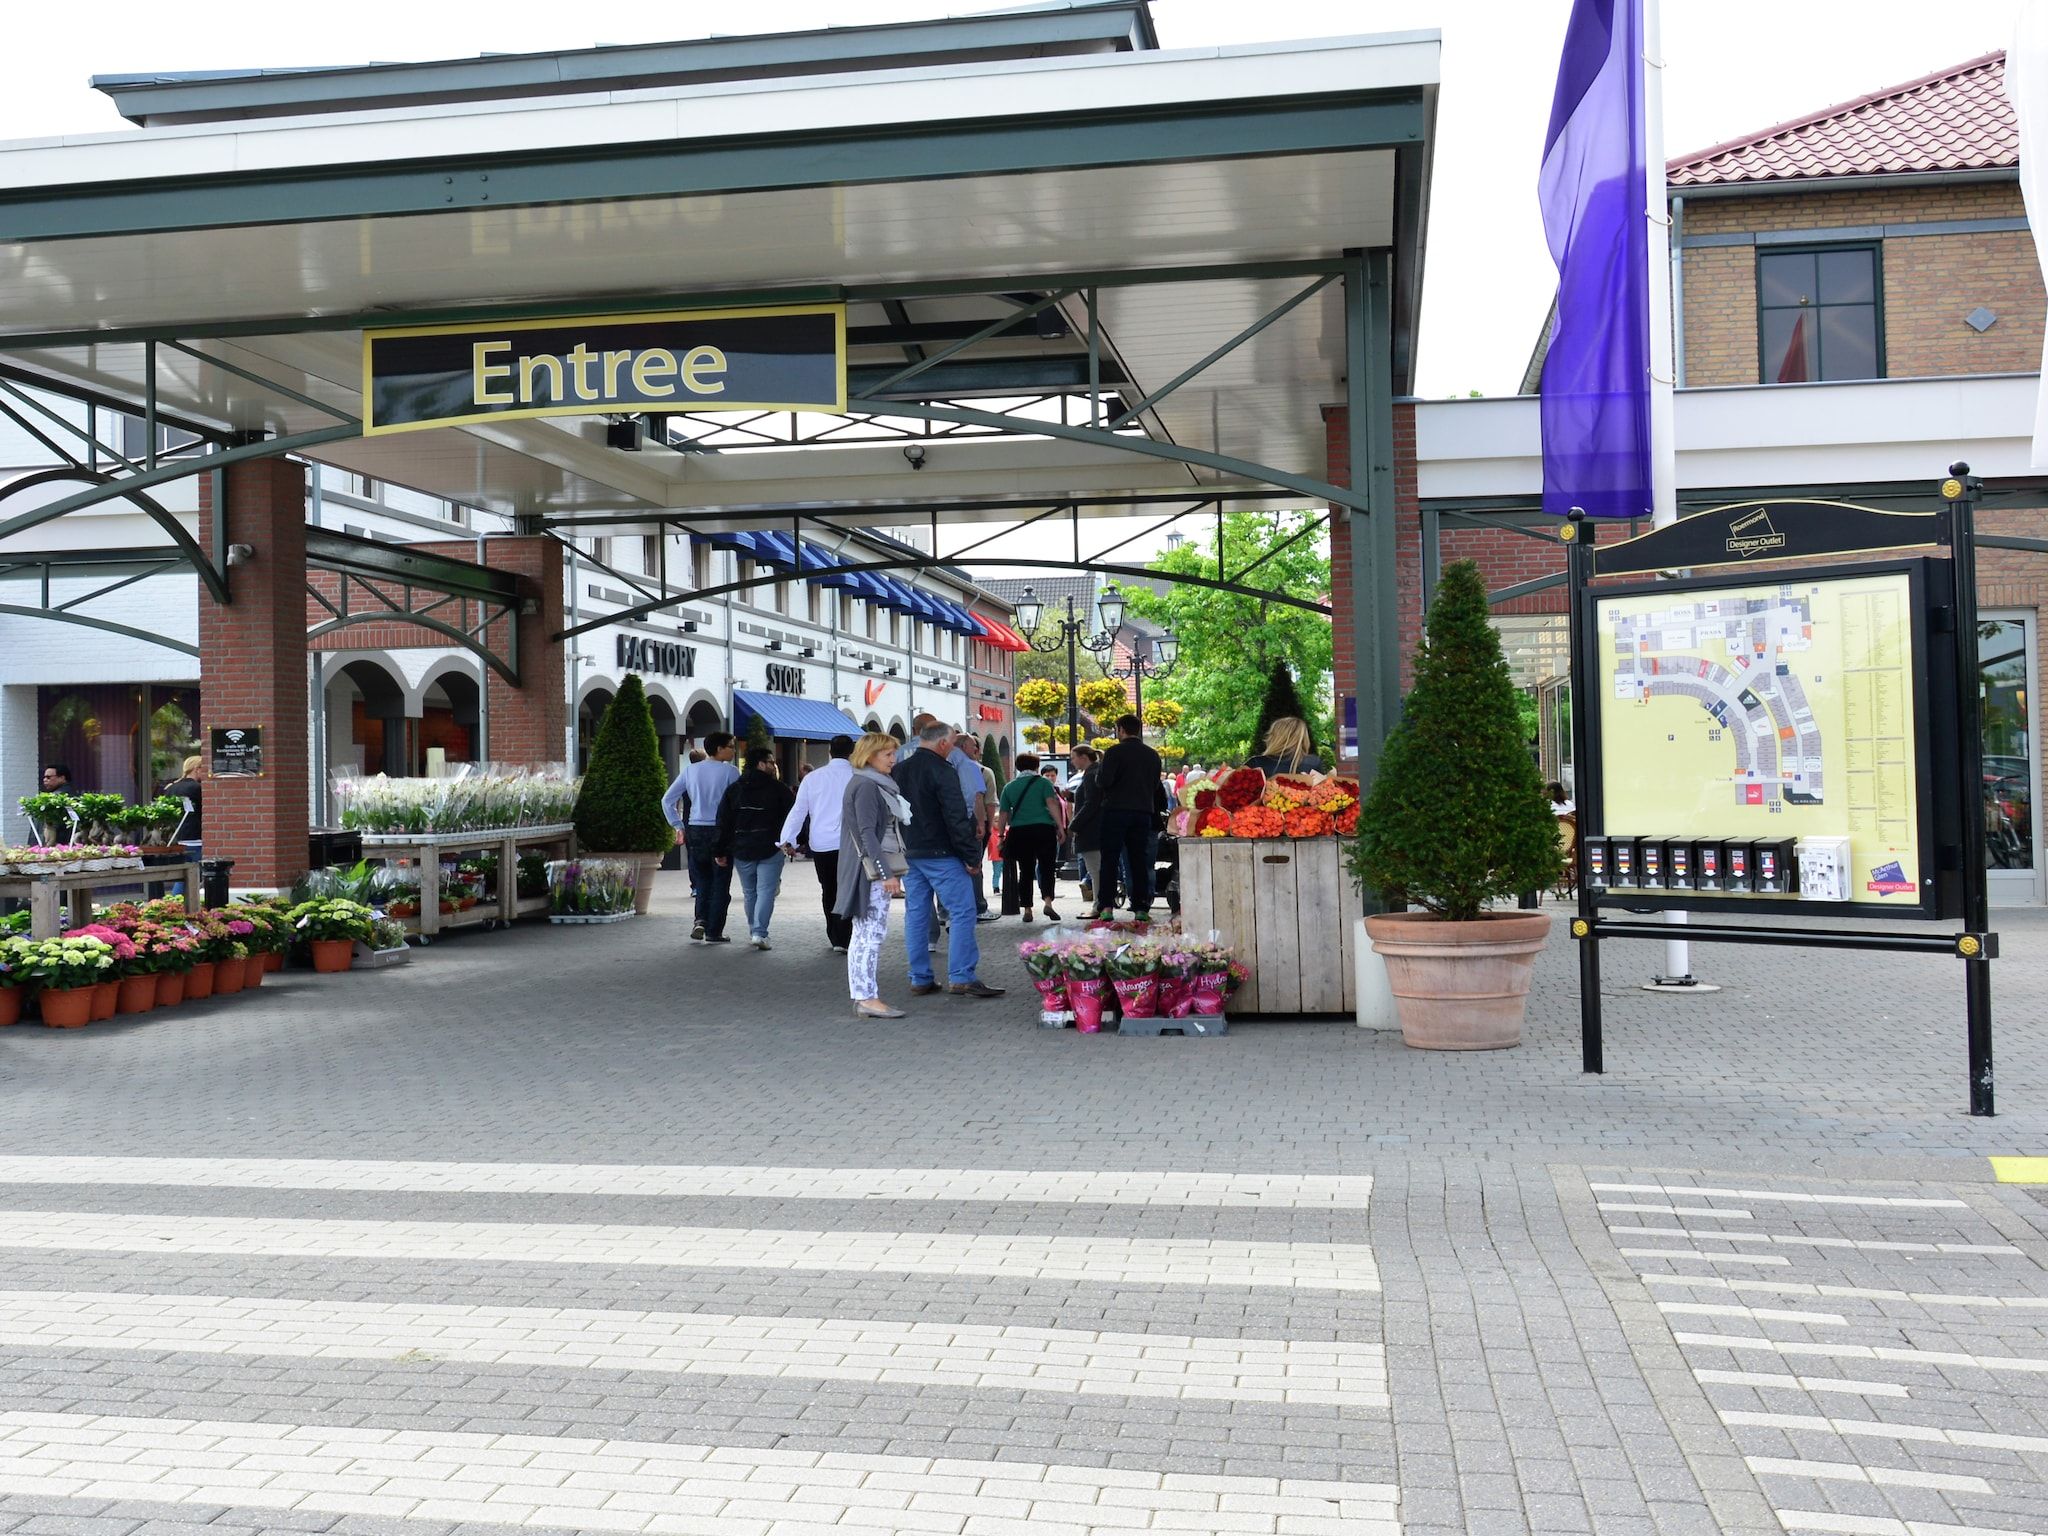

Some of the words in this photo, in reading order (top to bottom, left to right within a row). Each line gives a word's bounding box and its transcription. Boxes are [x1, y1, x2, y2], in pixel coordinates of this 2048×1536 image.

[473, 340, 728, 405] Entree
[1732, 511, 1765, 532] Roermond
[1729, 540, 1759, 549] Designer
[1760, 537, 1782, 546] Outlet
[617, 634, 698, 677] FACTORY
[766, 663, 807, 694] STORE
[1869, 883, 1893, 892] Designer
[1894, 883, 1913, 891] Outlet
